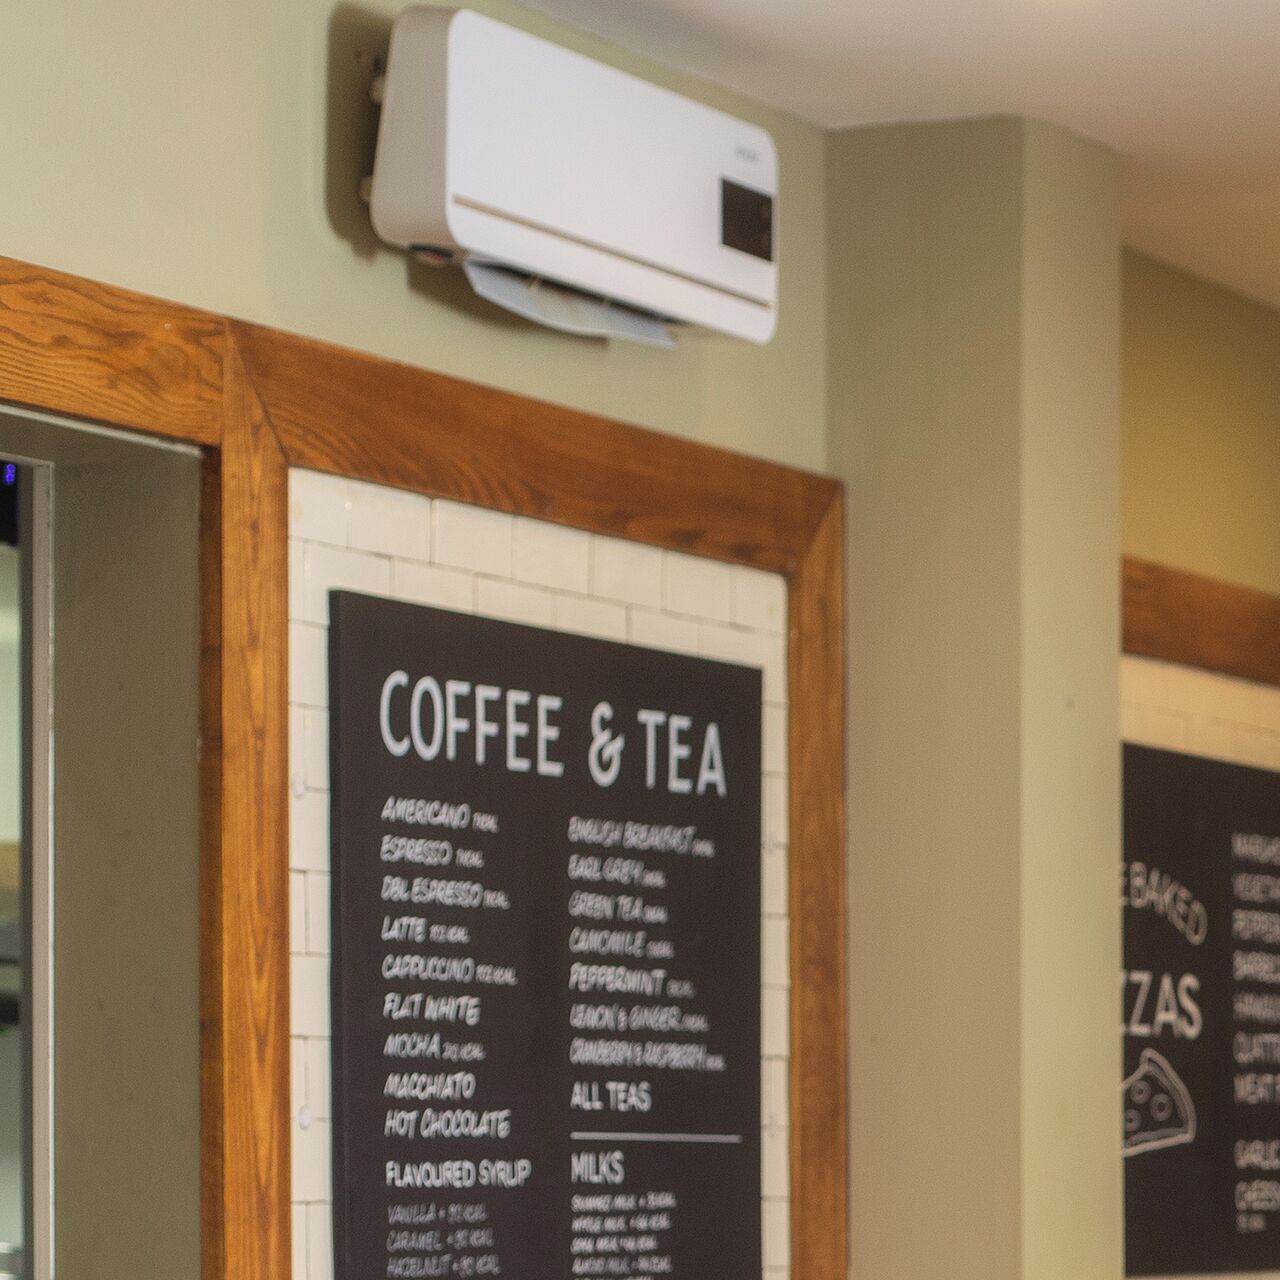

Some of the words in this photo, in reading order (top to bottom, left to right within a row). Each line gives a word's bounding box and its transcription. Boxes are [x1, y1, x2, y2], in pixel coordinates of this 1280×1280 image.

[379, 670, 564, 777] COFFEE
[588, 701, 625, 787] &
[637, 708, 727, 798] TEA
[381, 796, 471, 830] AMERICANO
[380, 834, 453, 866] ESPRESSO
[411, 877, 484, 908] ESPRESSO
[381, 915, 427, 943] LATTE
[381, 954, 475, 983] CAPPUCCINO
[383, 992, 424, 1020] FLAT
[424, 994, 481, 1026] WHITE
[1122, 970, 1202, 1040] ZAS
[383, 1032, 441, 1059] MOCHA
[383, 1071, 476, 1100] MACCHIATO
[570, 1081, 604, 1111] ALL
[605, 1080, 652, 1112] TEAS
[384, 1109, 419, 1140] HOT
[420, 1107, 512, 1140] CHOCOLATE
[385, 1160, 476, 1188] FLAVOURED
[478, 1158, 532, 1188] SYRUP
[570, 1150, 625, 1184] MILKS
